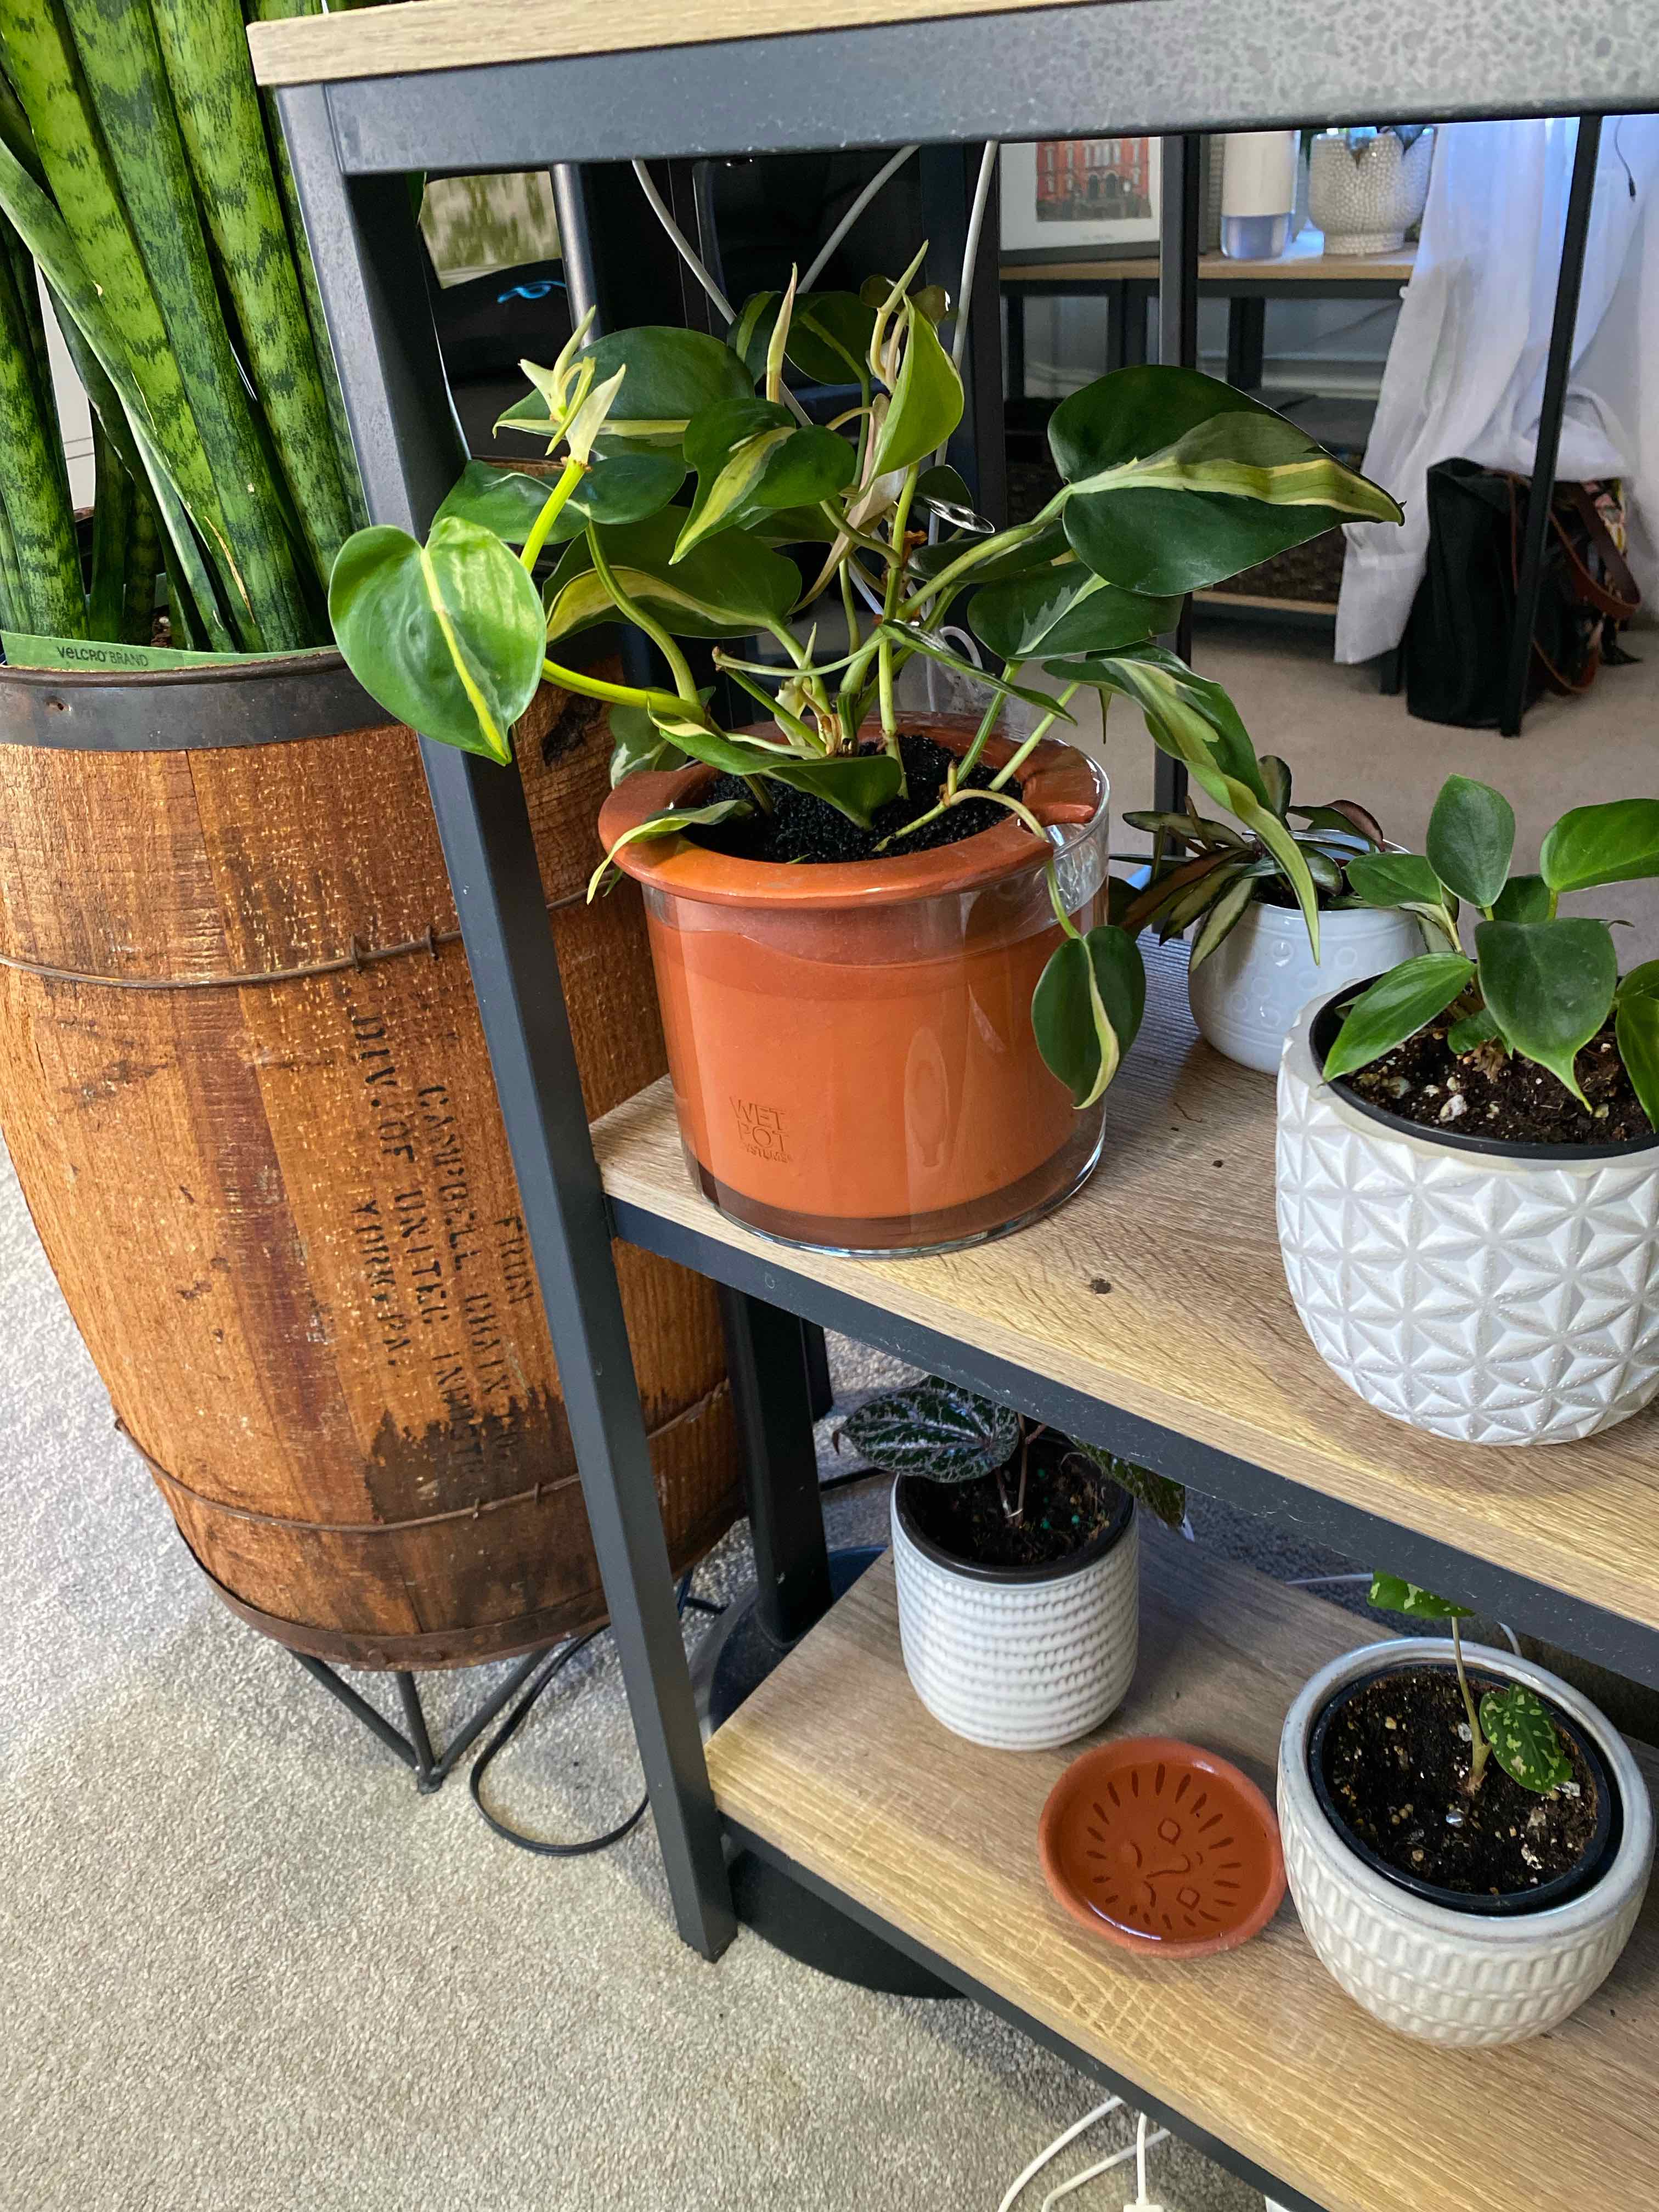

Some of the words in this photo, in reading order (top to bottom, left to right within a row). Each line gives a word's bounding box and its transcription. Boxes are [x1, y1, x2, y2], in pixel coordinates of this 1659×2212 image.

[110, 650, 149, 667] BRAND
[352, 1016, 398, 1108] DIV.
[377, 1121, 415, 1164] OF
[728, 1096, 787, 1131] WET
[736, 1119, 789, 1153] POT
[416, 1084, 482, 1271] CAMPBELL
[465, 1293, 510, 1395] CHAIN
